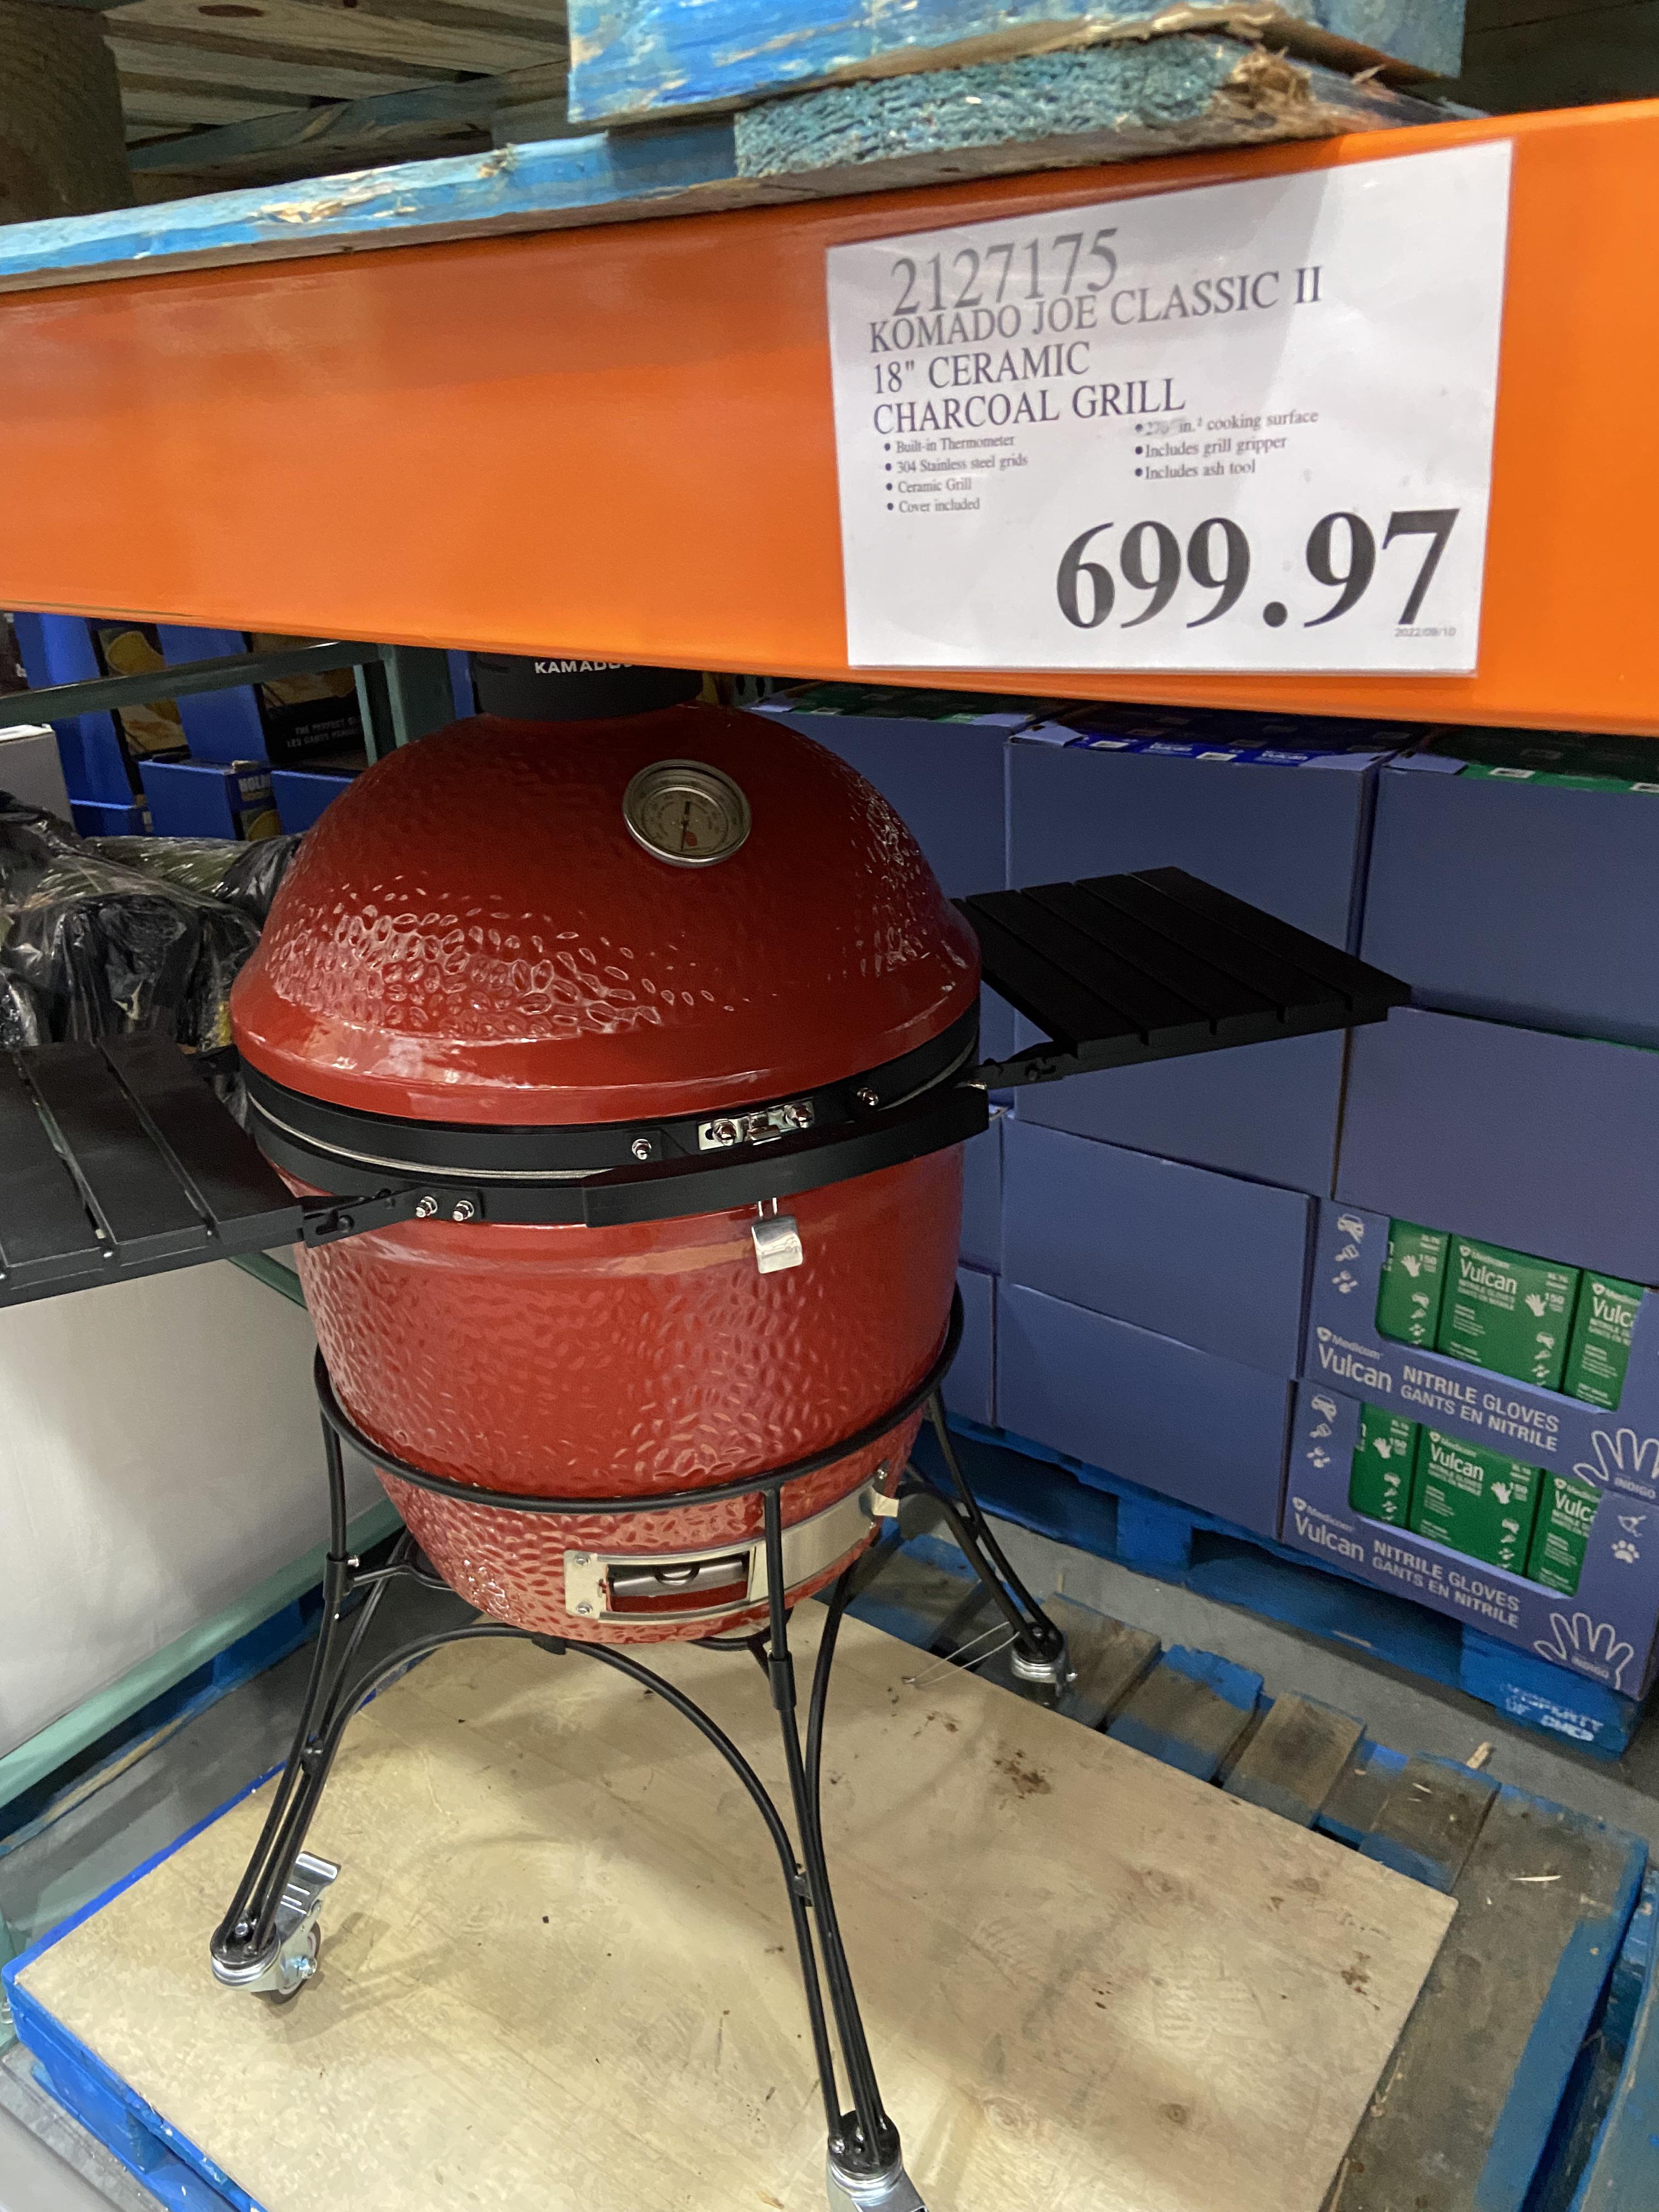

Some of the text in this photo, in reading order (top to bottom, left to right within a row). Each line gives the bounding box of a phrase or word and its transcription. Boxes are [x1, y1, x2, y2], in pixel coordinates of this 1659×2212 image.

[891, 228, 1118, 316] 2127175
[869, 266, 1322, 353] KOMADO JOE CLASSIC II
[873, 340, 1091, 394] 18" CERAMIC
[873, 378, 1186, 434] CHARCOAL GRILL
[1207, 414, 1262, 431] cooking
[1266, 411, 1318, 427] surface
[896, 436, 1015, 453] Built-in Thermometer
[896, 453, 1028, 473] 304 Stainless steel grids
[1146, 437, 1287, 458] Includes grill gripper
[1146, 459, 1255, 479] Includes ash tool
[898, 478, 972, 493] Ceramic Grill
[899, 498, 980, 514] Cover included
[1057, 508, 1460, 629] 699.97
[1460, 1258, 1517, 1294] Vulcan
[1318, 1344, 1392, 1393] Vulcan
[1400, 1385, 1455, 1415] GANTS
[1460, 1404, 1482, 1425] EN
[1488, 1415, 1558, 1453] NITRILE
[1403, 1365, 1477, 1404] NITRILE
[1483, 1394, 1559, 1433] GLOVES
[1431, 1443, 1483, 1481] Vulcan
[1295, 1513, 1364, 1562] Vulcan
[1372, 1557, 1519, 1629] GANTS EN NITRILE
[1373, 1539, 1442, 1581] NITRILE
[1448, 1571, 1520, 1612] GLOVES
